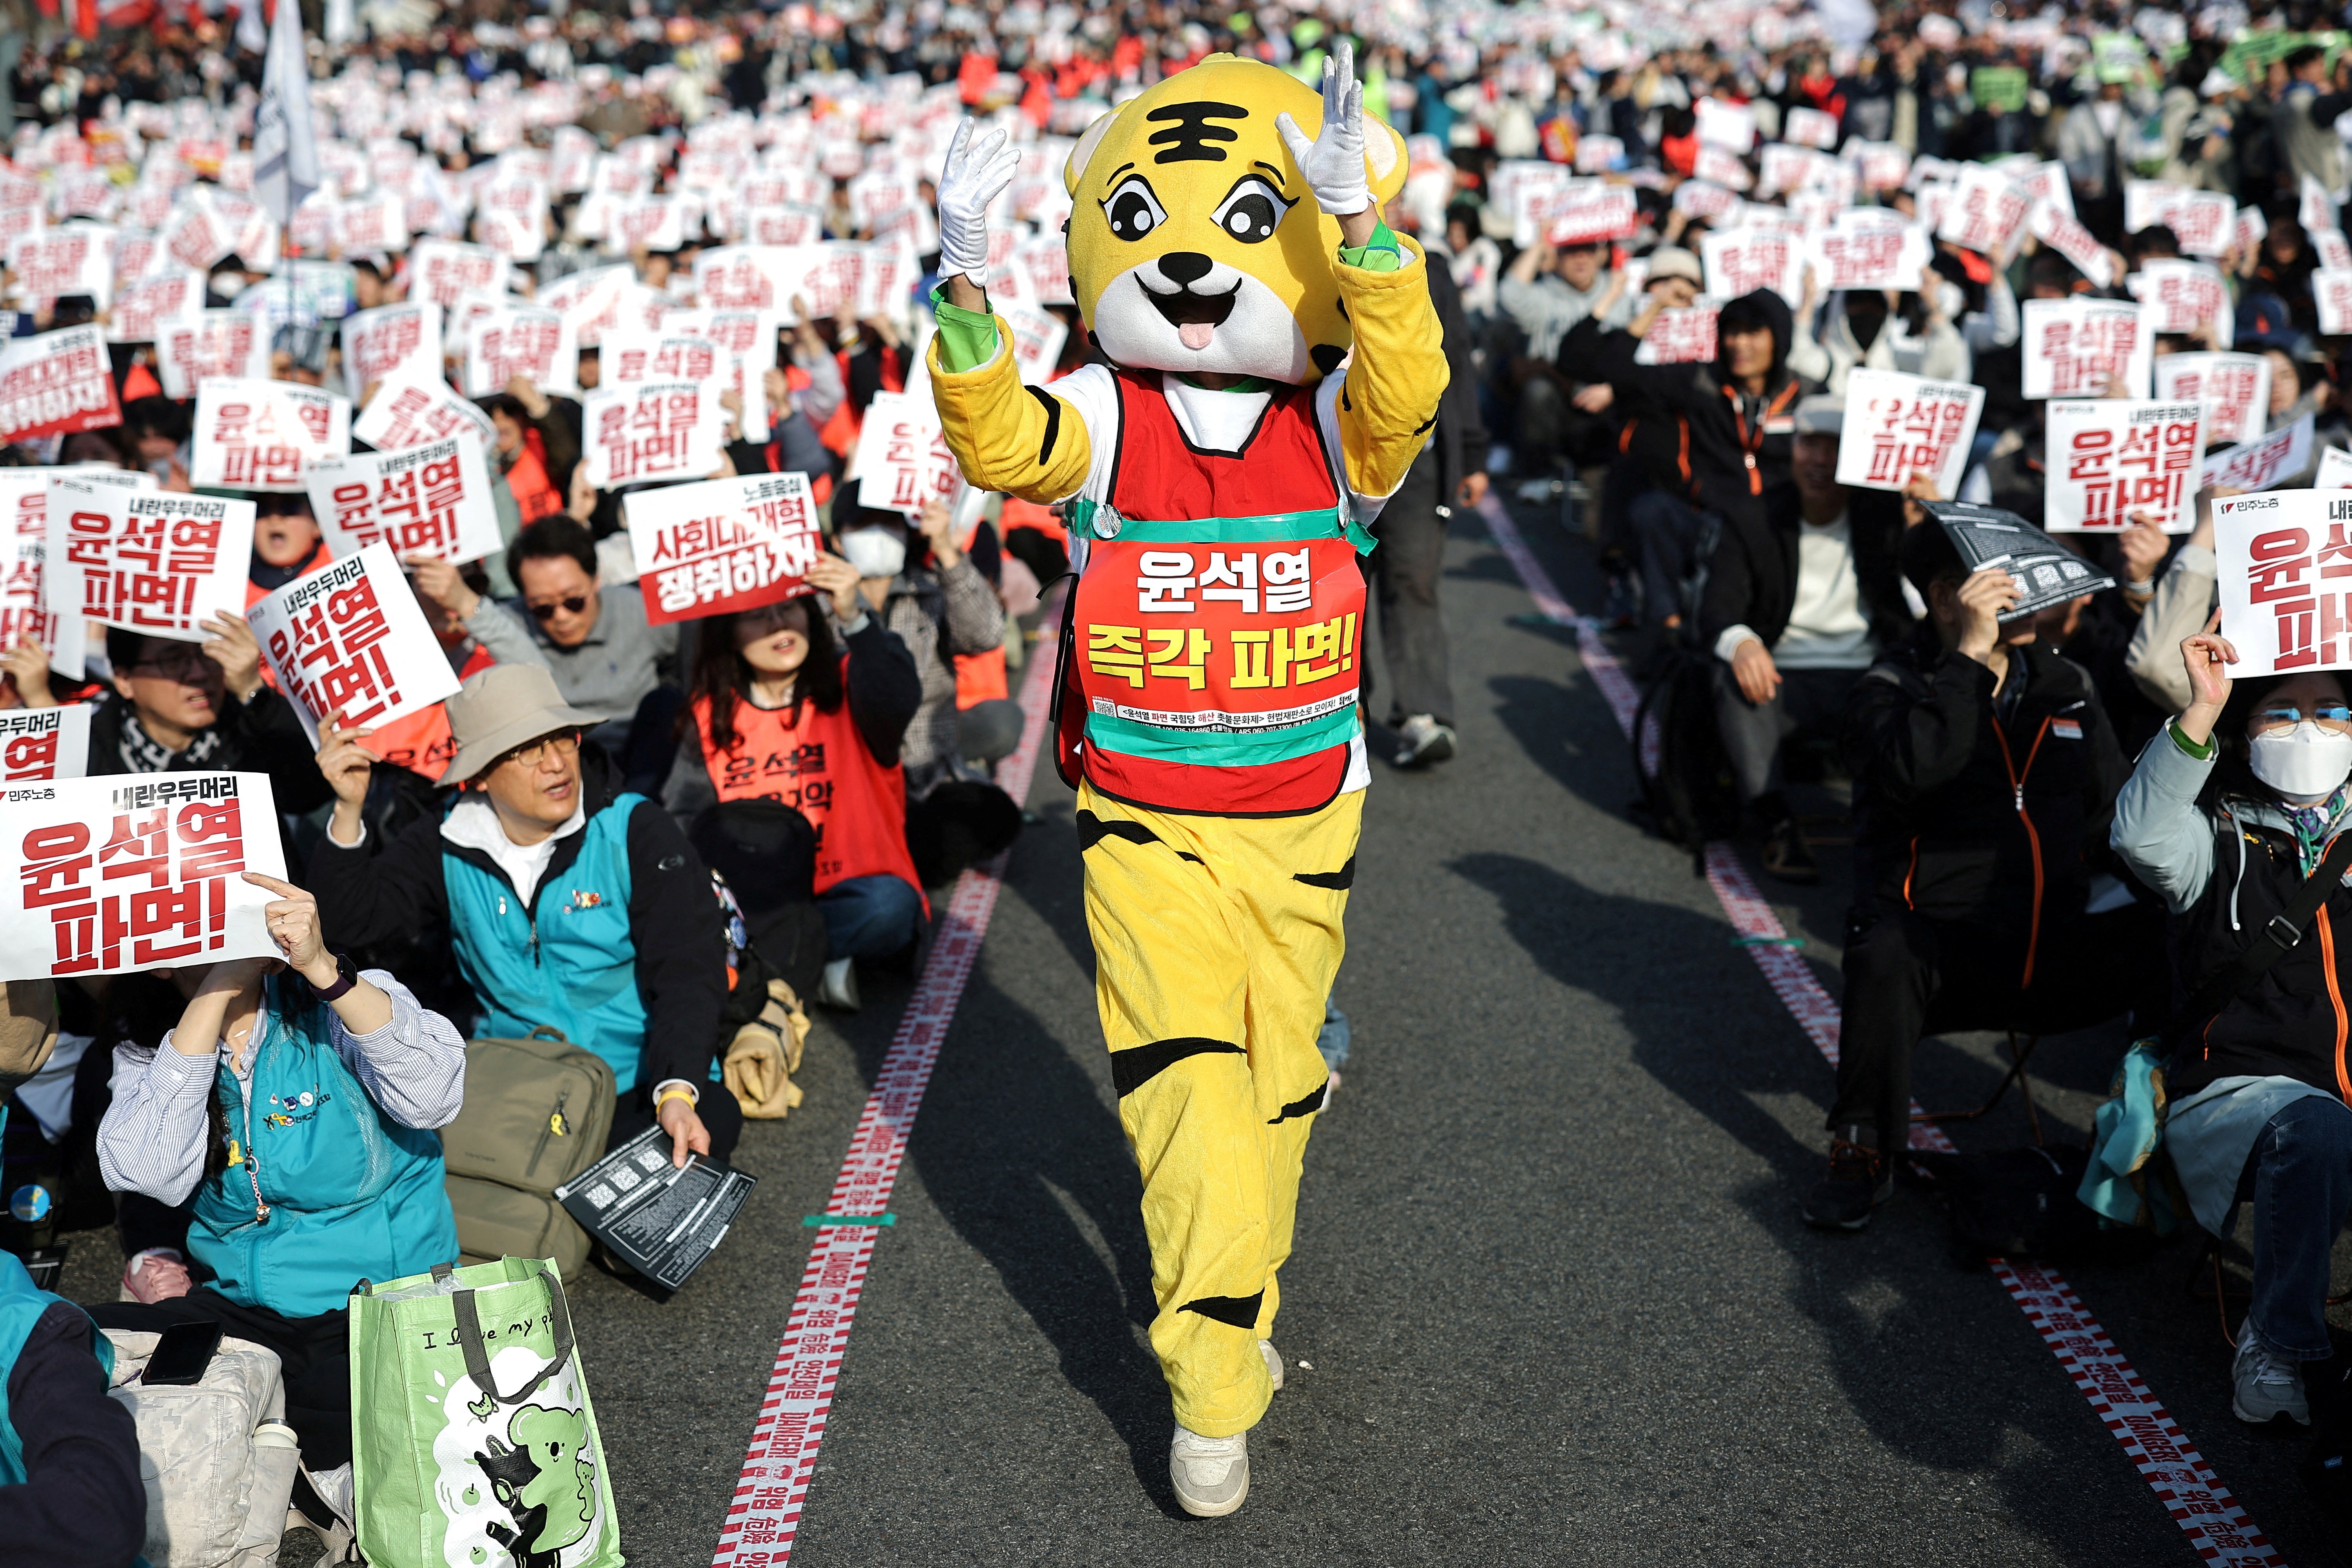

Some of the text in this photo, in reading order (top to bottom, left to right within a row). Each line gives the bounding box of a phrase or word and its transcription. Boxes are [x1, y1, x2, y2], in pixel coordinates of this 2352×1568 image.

[599, 392, 698, 446] 윤석열
[609, 430, 689, 481] 파면!
[2070, 421, 2198, 480] 윤석열
[129, 497, 226, 518] 내란우두머리
[333, 456, 464, 531] 윤석열
[744, 477, 802, 503] 노동중심
[2082, 473, 2183, 527] 파면!
[2237, 497, 2279, 512] 민주노총
[2329, 500, 2352, 520] 내
[67, 510, 222, 573] 윤석열
[82, 568, 197, 629] 파면!
[283, 555, 365, 615] 내란우두머리
[1138, 547, 1312, 613] 윤석열
[269, 575, 391, 697] 윤석열
[1089, 612, 1356, 690] 즉각 파면!
[2274, 592, 2352, 671] 파
[301, 643, 403, 730] 파면!
[1123, 709, 1149, 720] <윤석열
[1152, 713, 1168, 723] 파면
[1170, 714, 1196, 724] 국힘당
[1198, 712, 1215, 723] 해산
[1217, 713, 1265, 725] 촛불문화제>
[1267, 707, 1312, 723] 헌법재판소로
[1314, 699, 1336, 713] 모이자!
[1211, 725, 1233, 733] 촛불행동
[9, 788, 55, 802] 민주노총
[113, 776, 238, 811] 내란우두머리
[20, 797, 245, 909] 윤석열
[51, 876, 225, 975] 파면!
[423, 1332, 437, 1349] I
[508, 1318, 532, 1337] my
[806, 1310, 838, 1328] 위험
[2045, 1312, 2085, 1332] 위험
[799, 1333, 831, 1354] 危險
[784, 1360, 824, 1400] 안전제일
[2083, 1362, 2140, 1403] 안전제일
[767, 1412, 811, 1459] DANGER!
[2121, 1415, 2186, 1463] DANGER!
[751, 1486, 789, 1510] 위험
[2178, 1490, 2225, 1515] 위험
[740, 1516, 780, 1545] 危險
[2200, 1520, 2251, 1549] 危險
